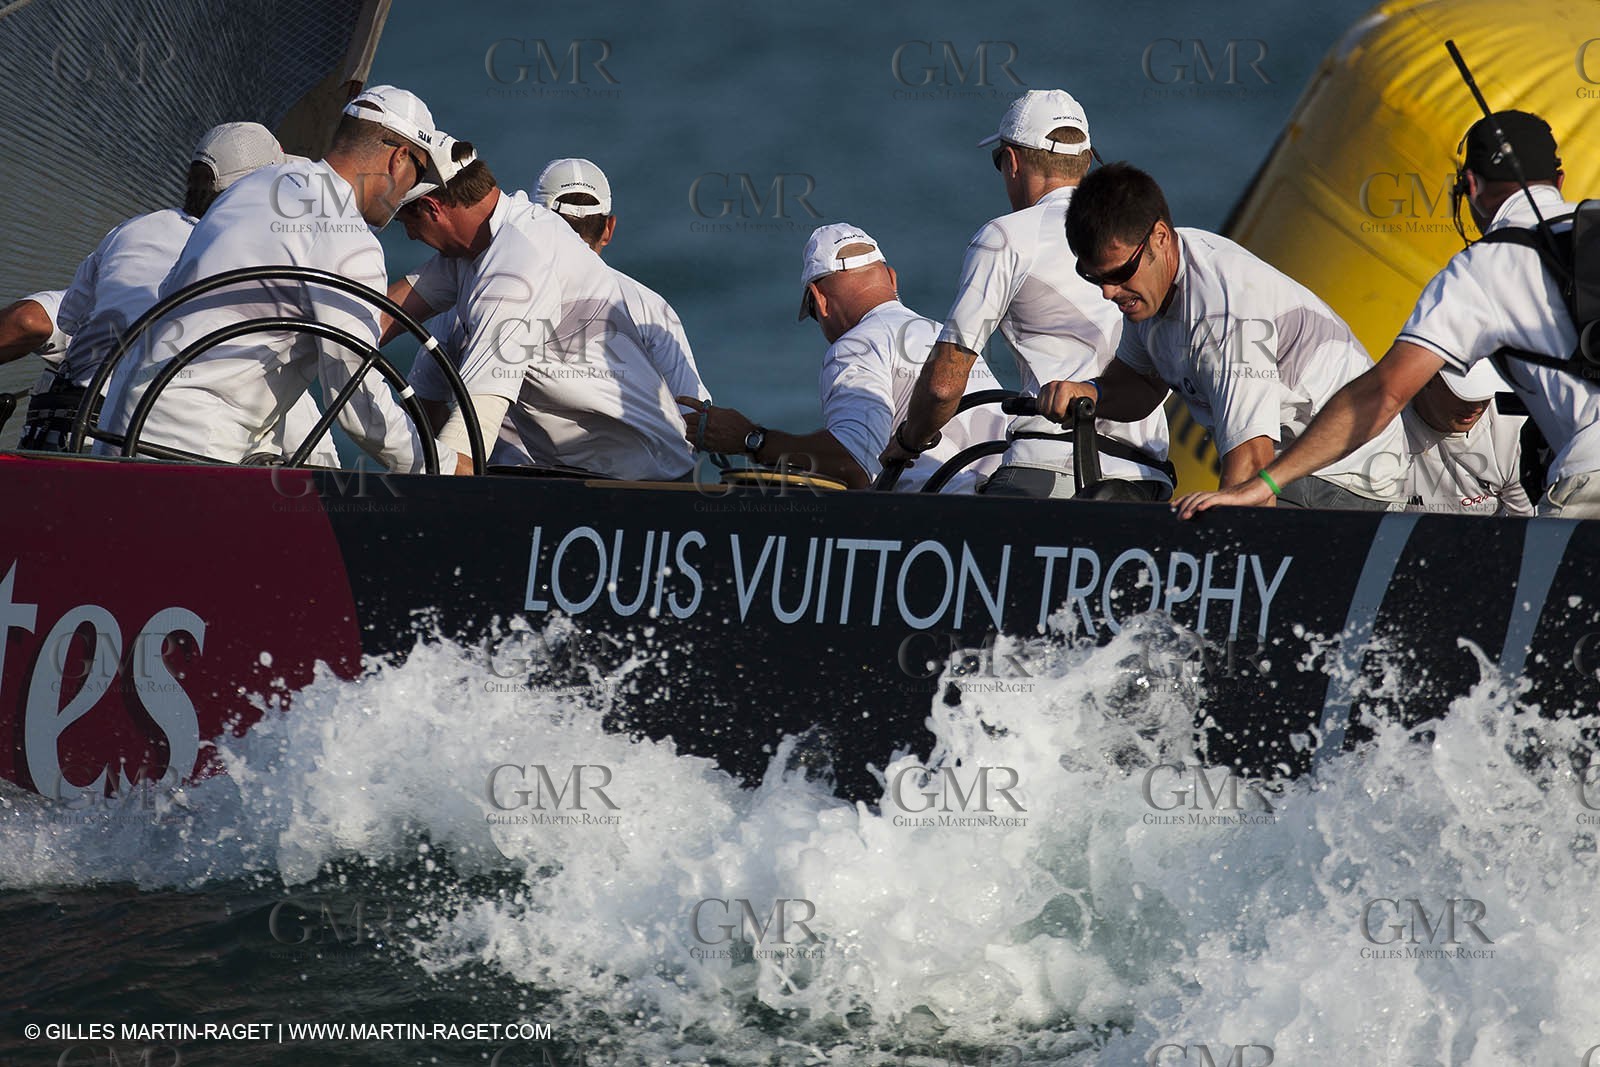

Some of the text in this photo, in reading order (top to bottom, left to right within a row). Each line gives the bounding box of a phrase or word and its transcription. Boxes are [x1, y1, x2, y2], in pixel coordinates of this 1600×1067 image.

[524, 525, 1293, 642] LOUIS VUITTON TROPHY
